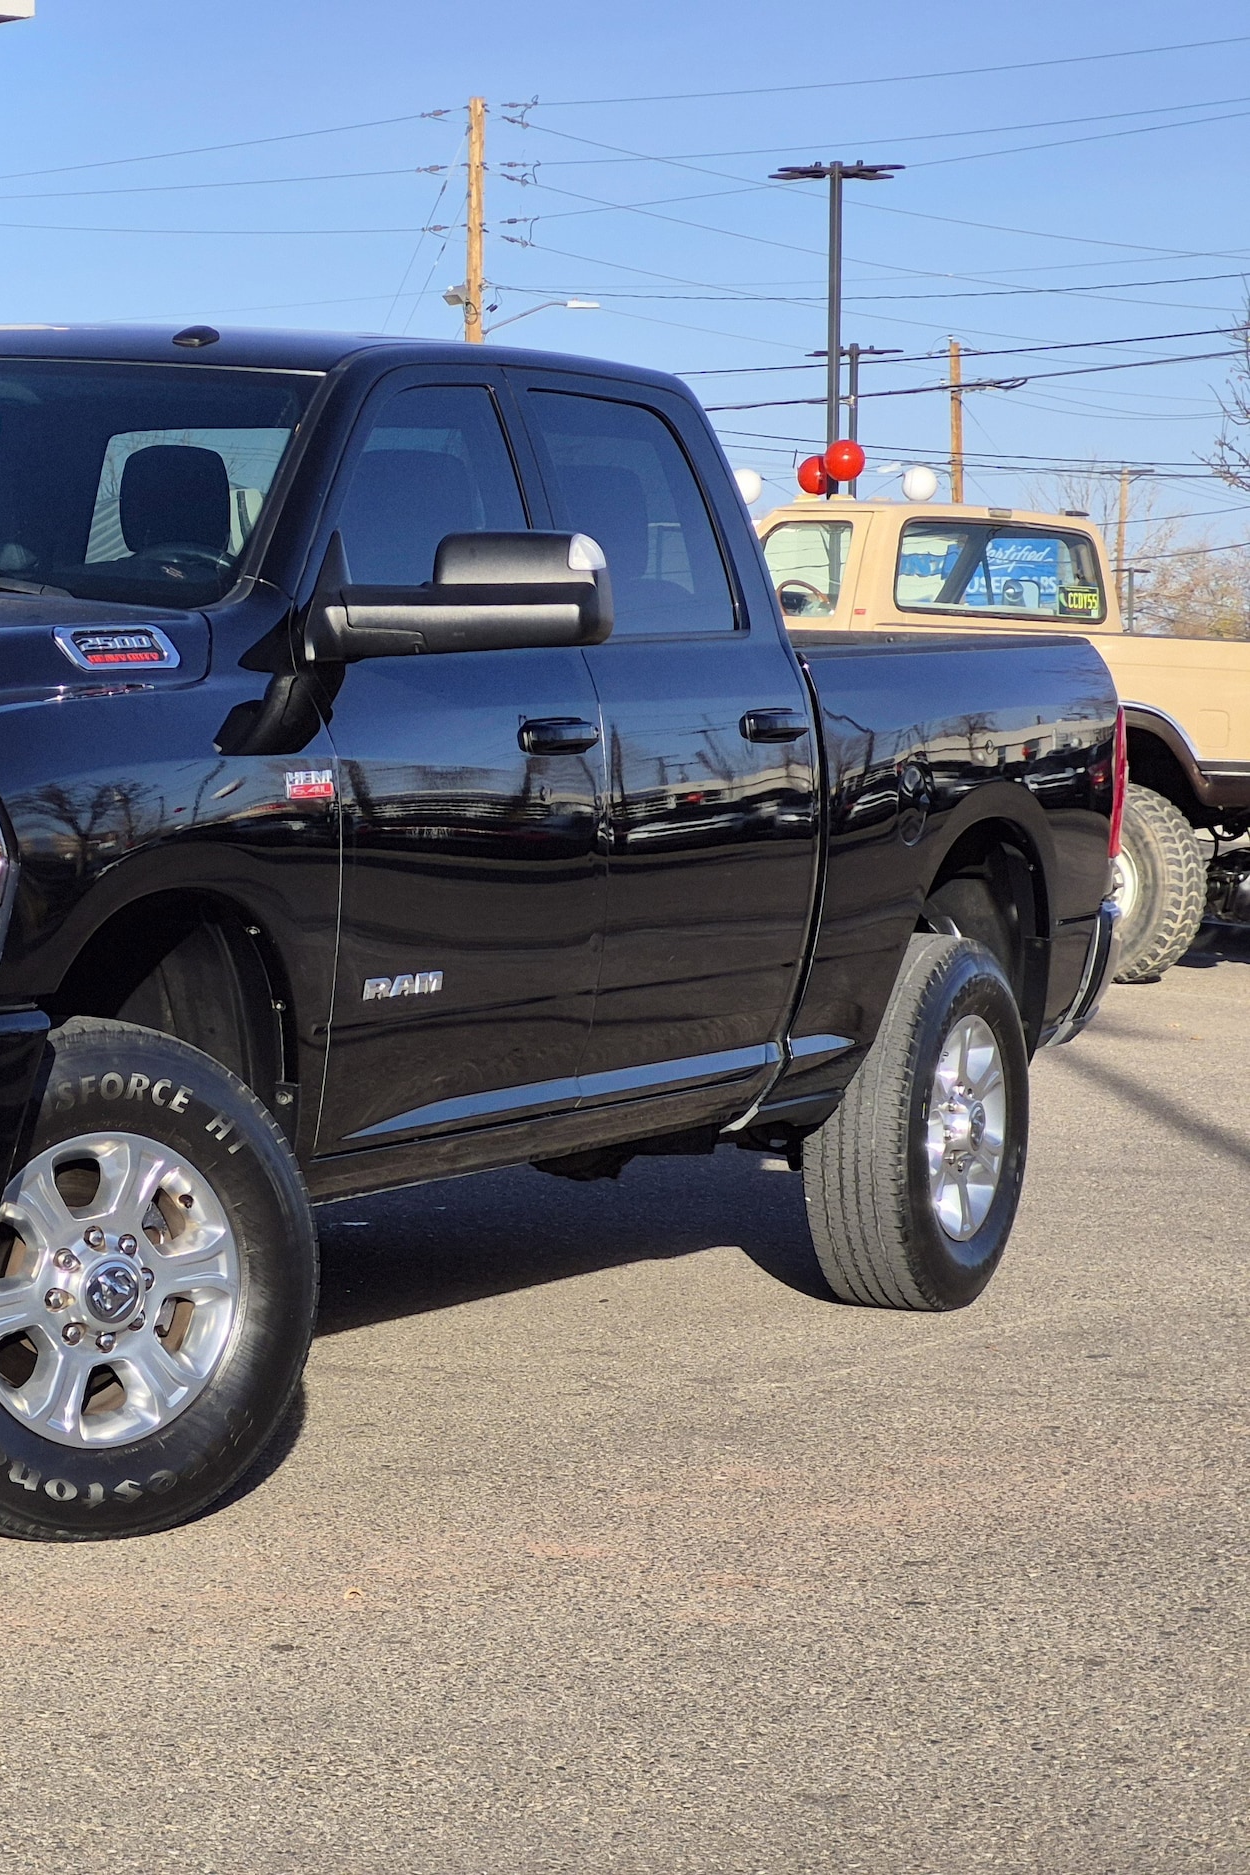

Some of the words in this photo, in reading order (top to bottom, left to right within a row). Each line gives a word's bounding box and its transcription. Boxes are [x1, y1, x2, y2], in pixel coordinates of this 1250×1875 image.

[75, 635, 152, 652] 2500
[362, 970, 444, 1001] RAM
[45, 1071, 194, 1114] SFORCE
